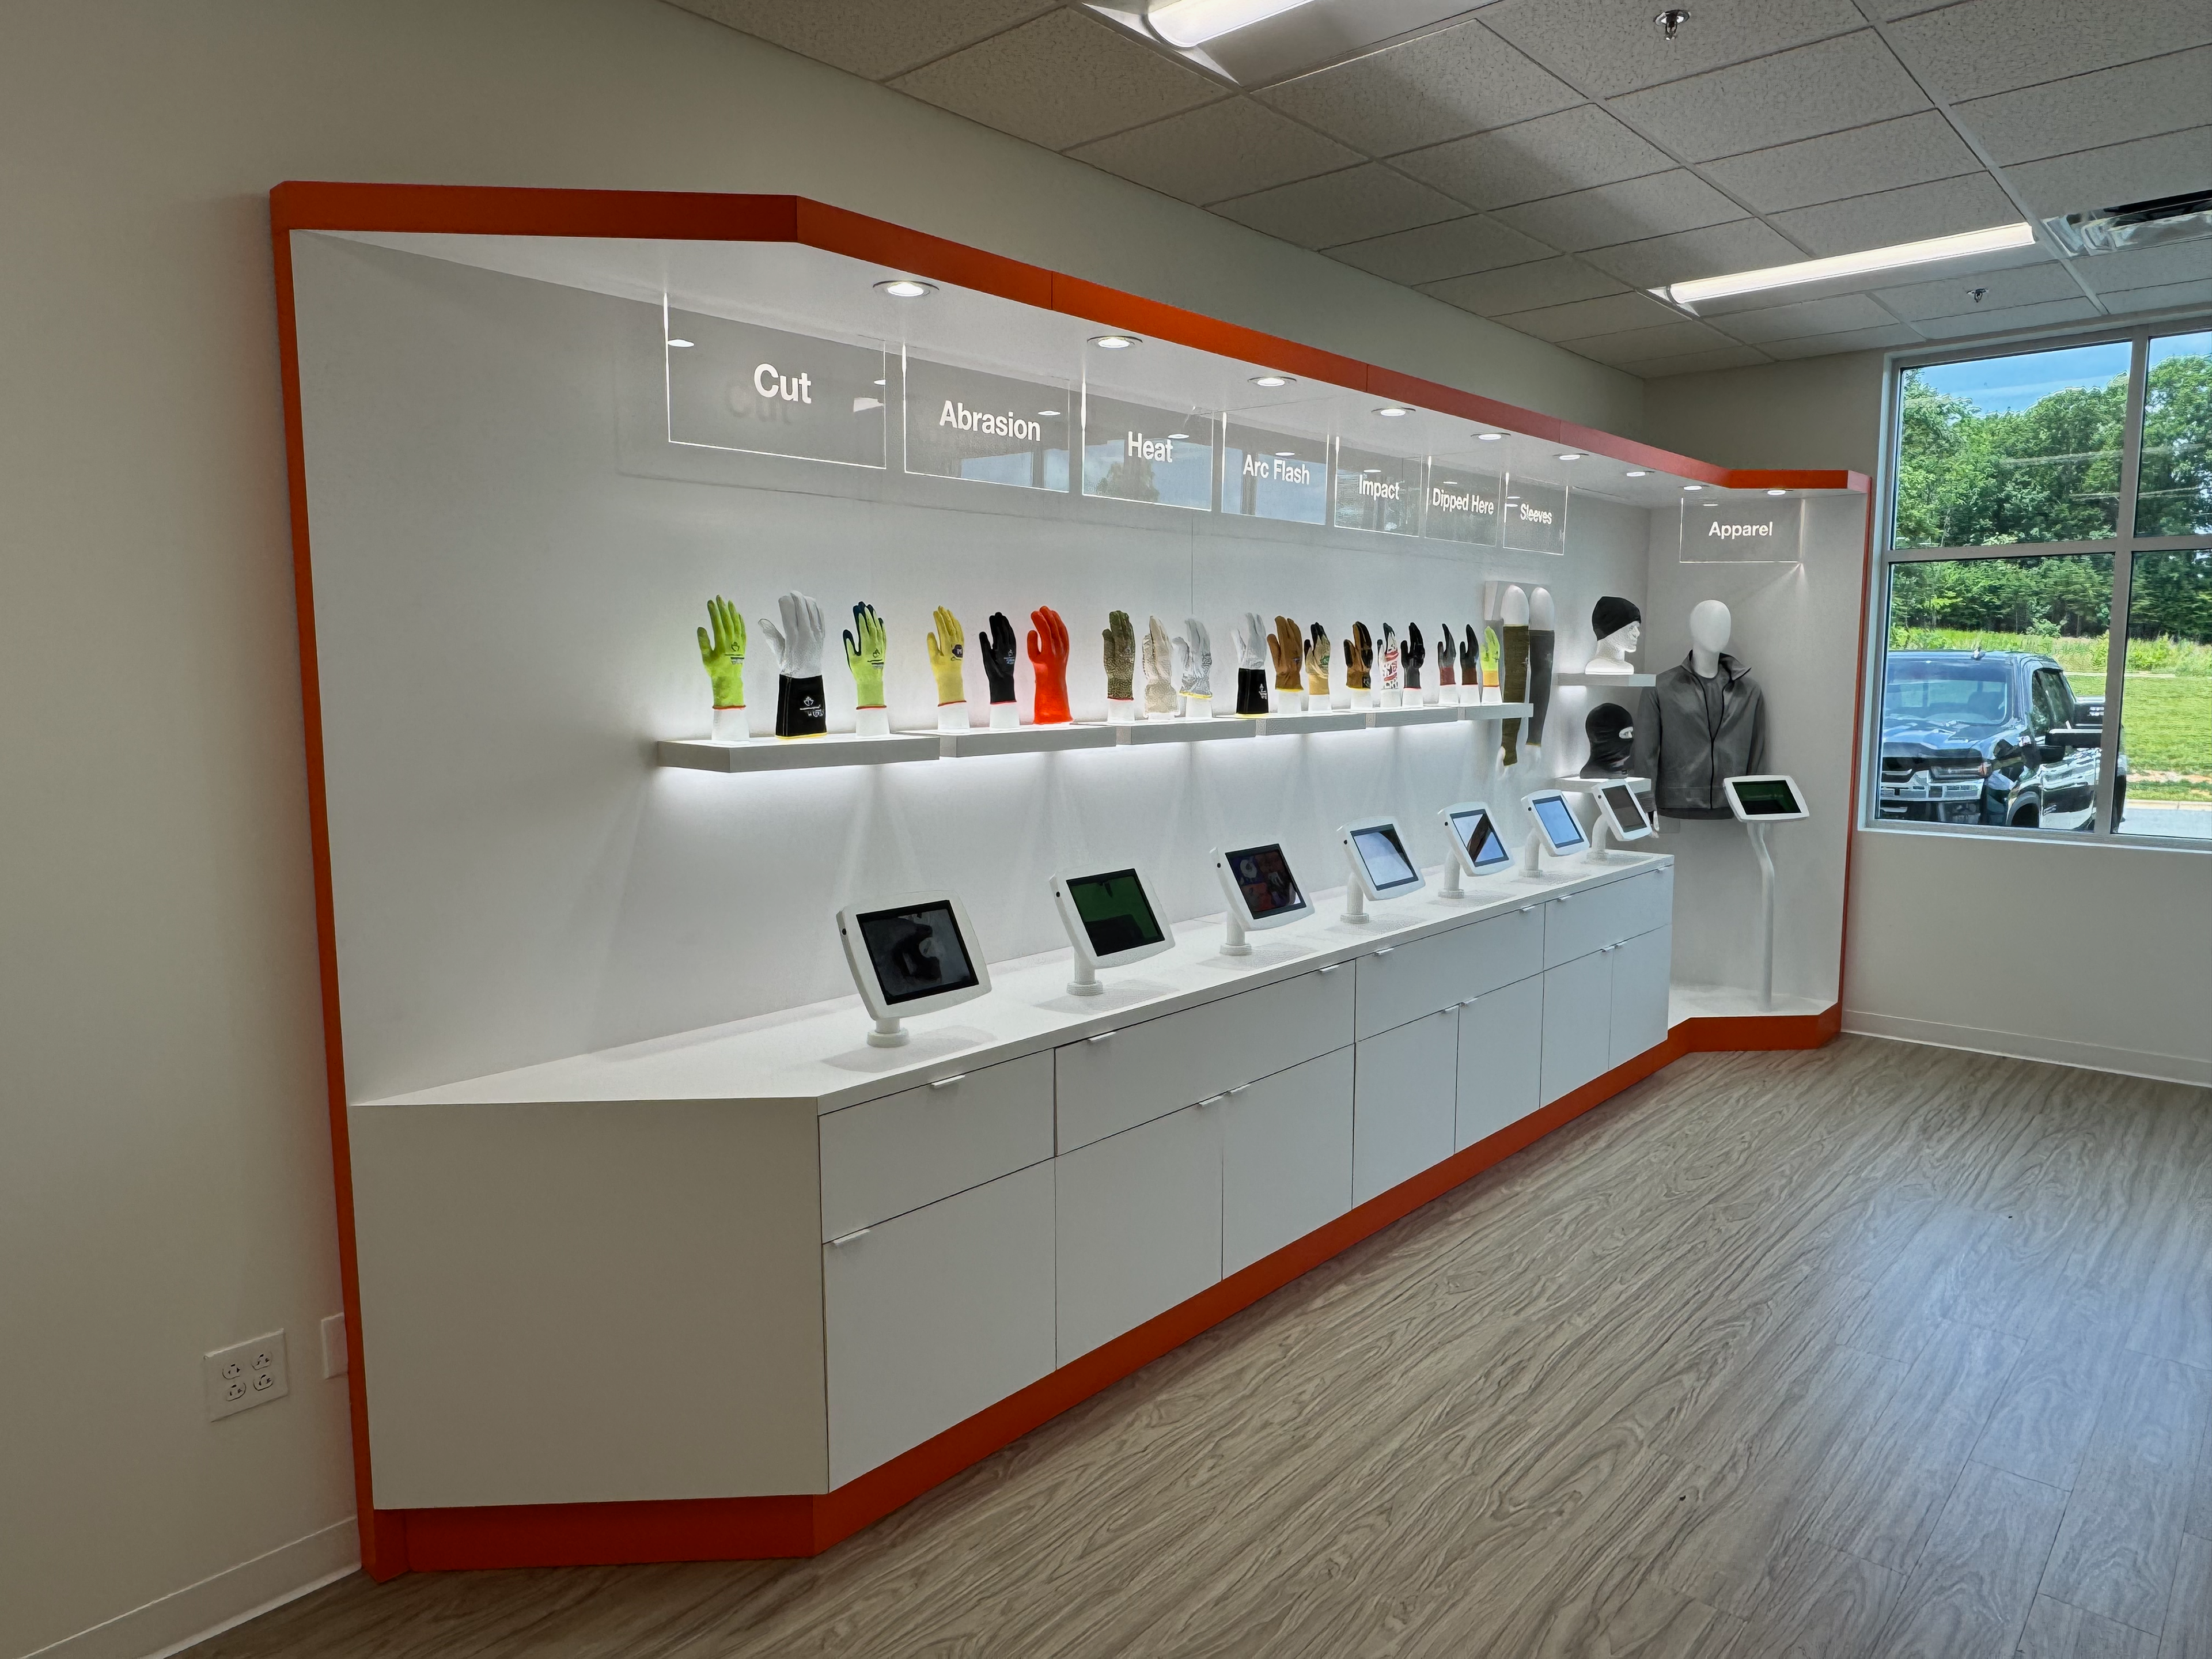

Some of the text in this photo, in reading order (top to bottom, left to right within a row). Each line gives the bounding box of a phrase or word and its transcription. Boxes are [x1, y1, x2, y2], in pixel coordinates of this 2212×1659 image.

[753, 363, 812, 404] Cut
[938, 400, 1041, 442] Abrasion
[1127, 431, 1173, 463] Heat
[1243, 454, 1310, 486] Arc Flash
[1358, 474, 1400, 501] Impact
[1432, 487, 1494, 516] Dipped Here
[1520, 503, 1553, 525] Sleeves
[1709, 521, 1773, 540] Apparel
